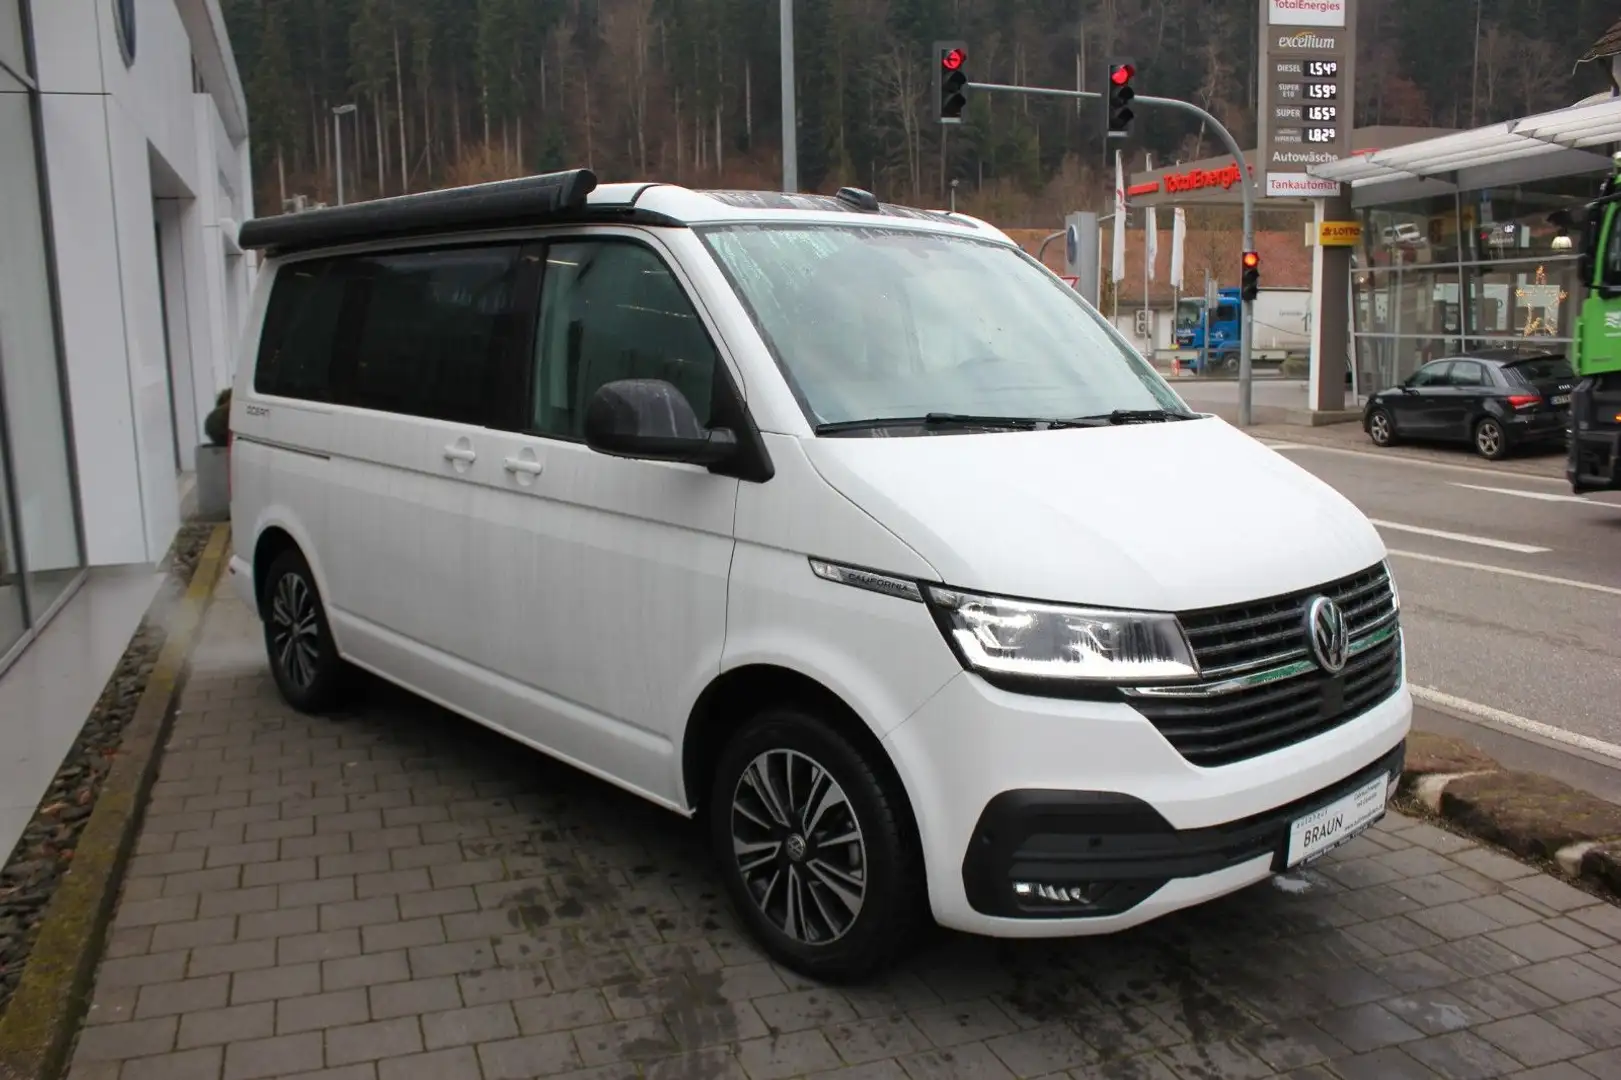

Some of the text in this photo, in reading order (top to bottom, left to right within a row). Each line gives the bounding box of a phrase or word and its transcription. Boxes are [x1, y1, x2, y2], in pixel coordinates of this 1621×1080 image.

[1275, 0, 1340, 12] TotalEnergies
[1279, 34, 1335, 48] excellium
[1277, 64, 1301, 72] DIESEL
[1278, 83, 1300, 91] SUPER
[1276, 108, 1300, 117] SUPER
[1272, 151, 1338, 162] Autowäsche
[1271, 180, 1337, 190] Tankautomat
[1333, 226, 1361, 236] LOTTO
[848, 573, 908, 590] CALIFORNIA
[1303, 813, 1344, 848] BRAUN
